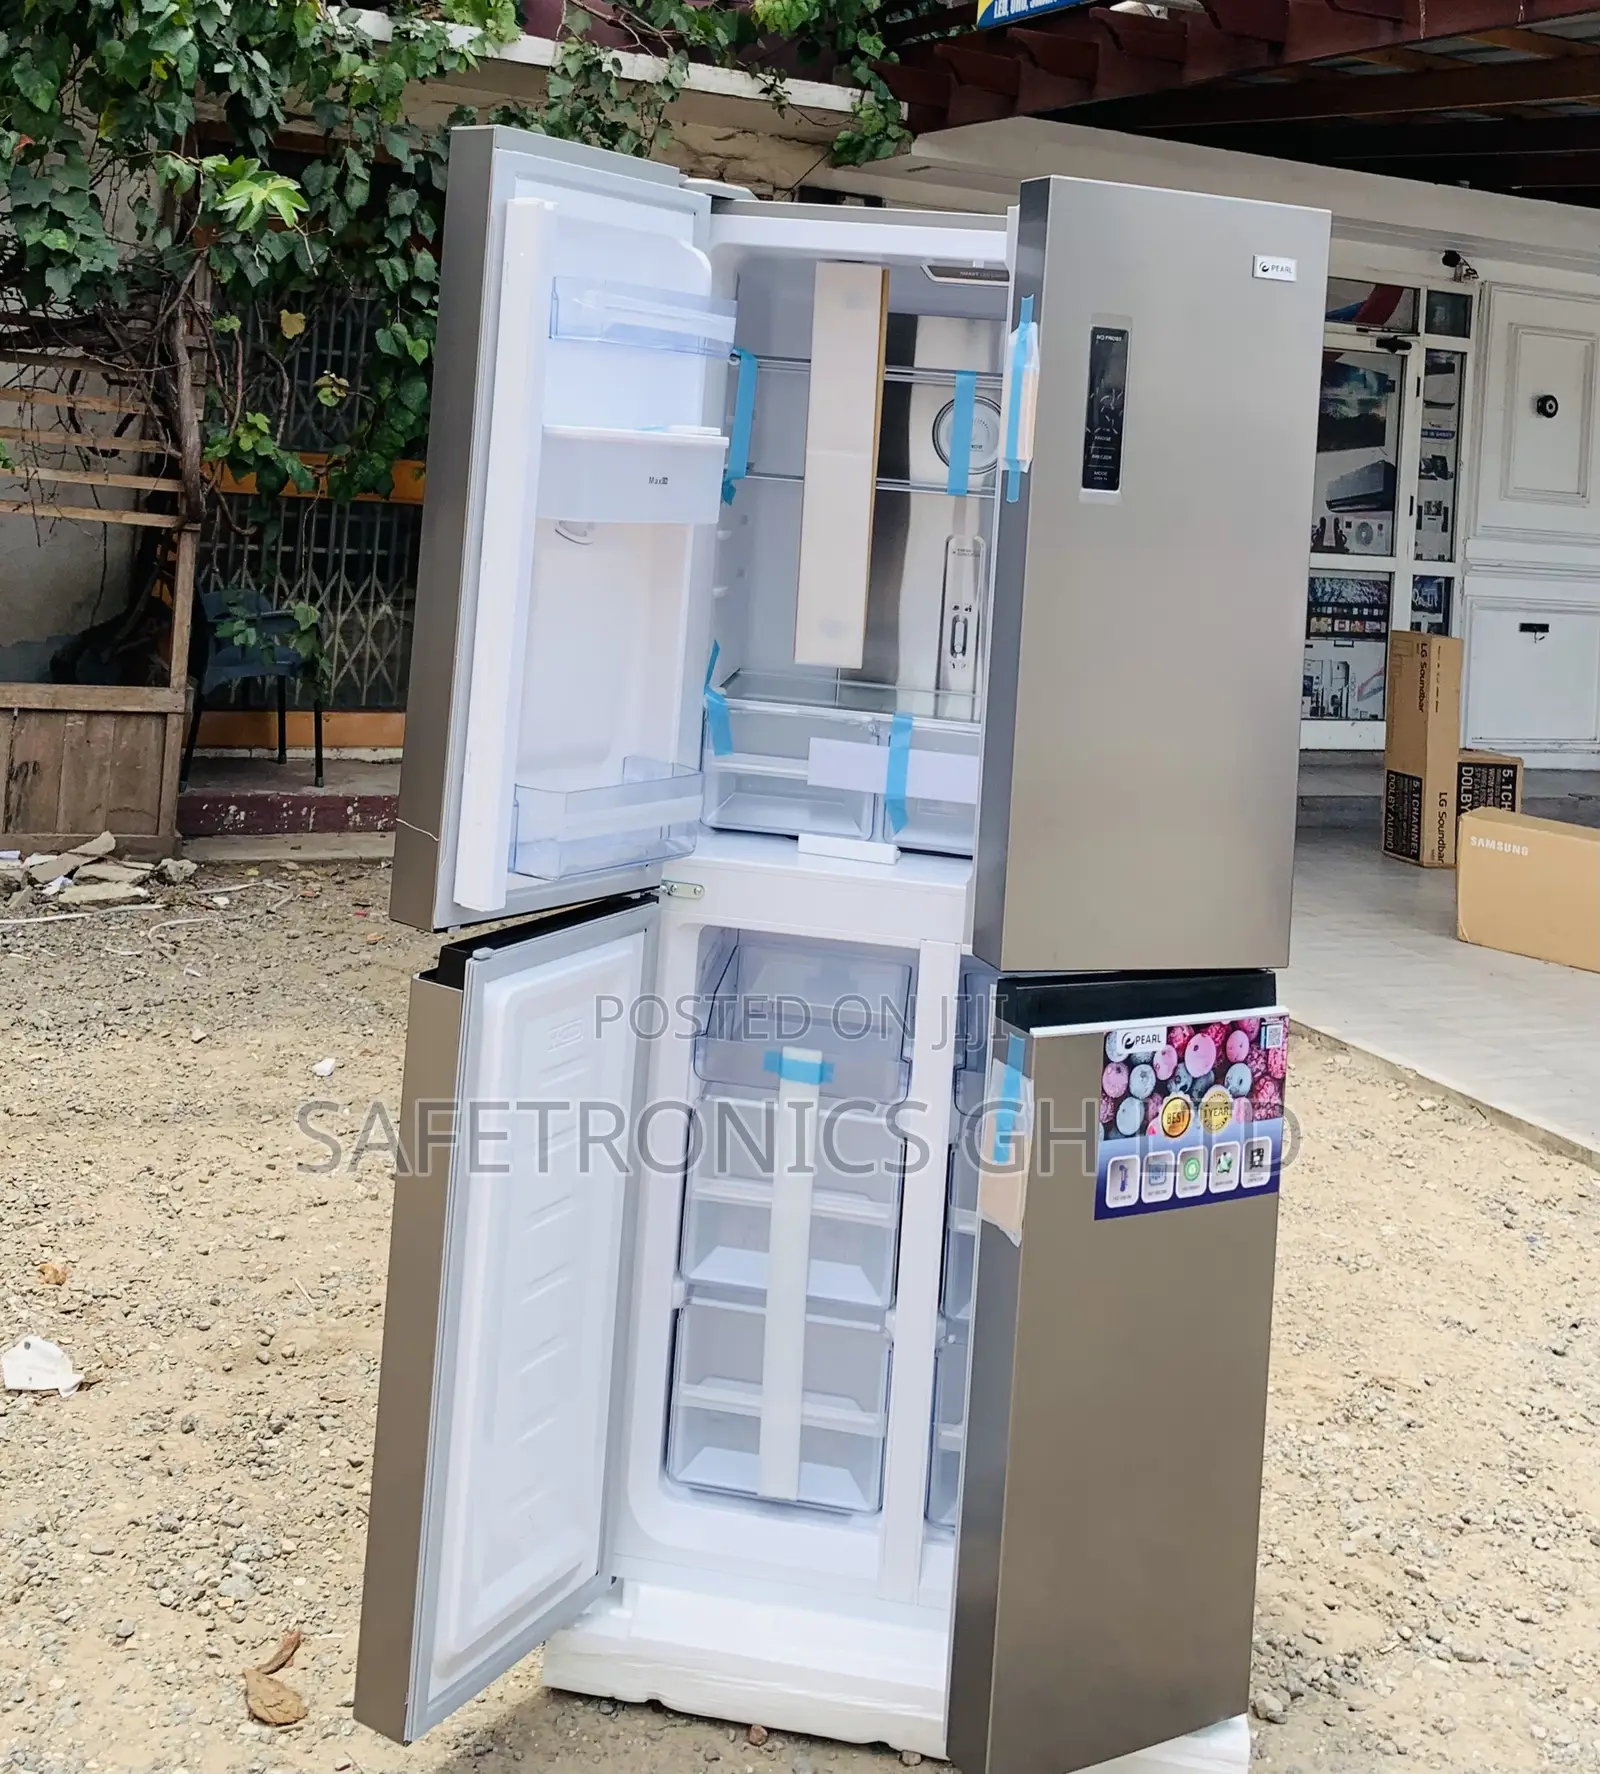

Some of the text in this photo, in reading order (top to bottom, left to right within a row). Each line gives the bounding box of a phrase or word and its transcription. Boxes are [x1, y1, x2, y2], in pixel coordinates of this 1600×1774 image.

[1270, 264, 1293, 274] PEARL
[1420, 642, 1428, 658] LG
[1418, 661, 1428, 713] Soundbar
[1460, 766, 1474, 812] DOLBY
[1385, 773, 1396, 849] DOLBY AUDIO
[1437, 791, 1448, 865] LG Soundbar
[1469, 835, 1529, 857] SAMSUNG
[1134, 1033, 1162, 1045] PEARL
[1166, 1110, 1186, 1125] BEST
[1209, 1106, 1230, 1118] YEAR
